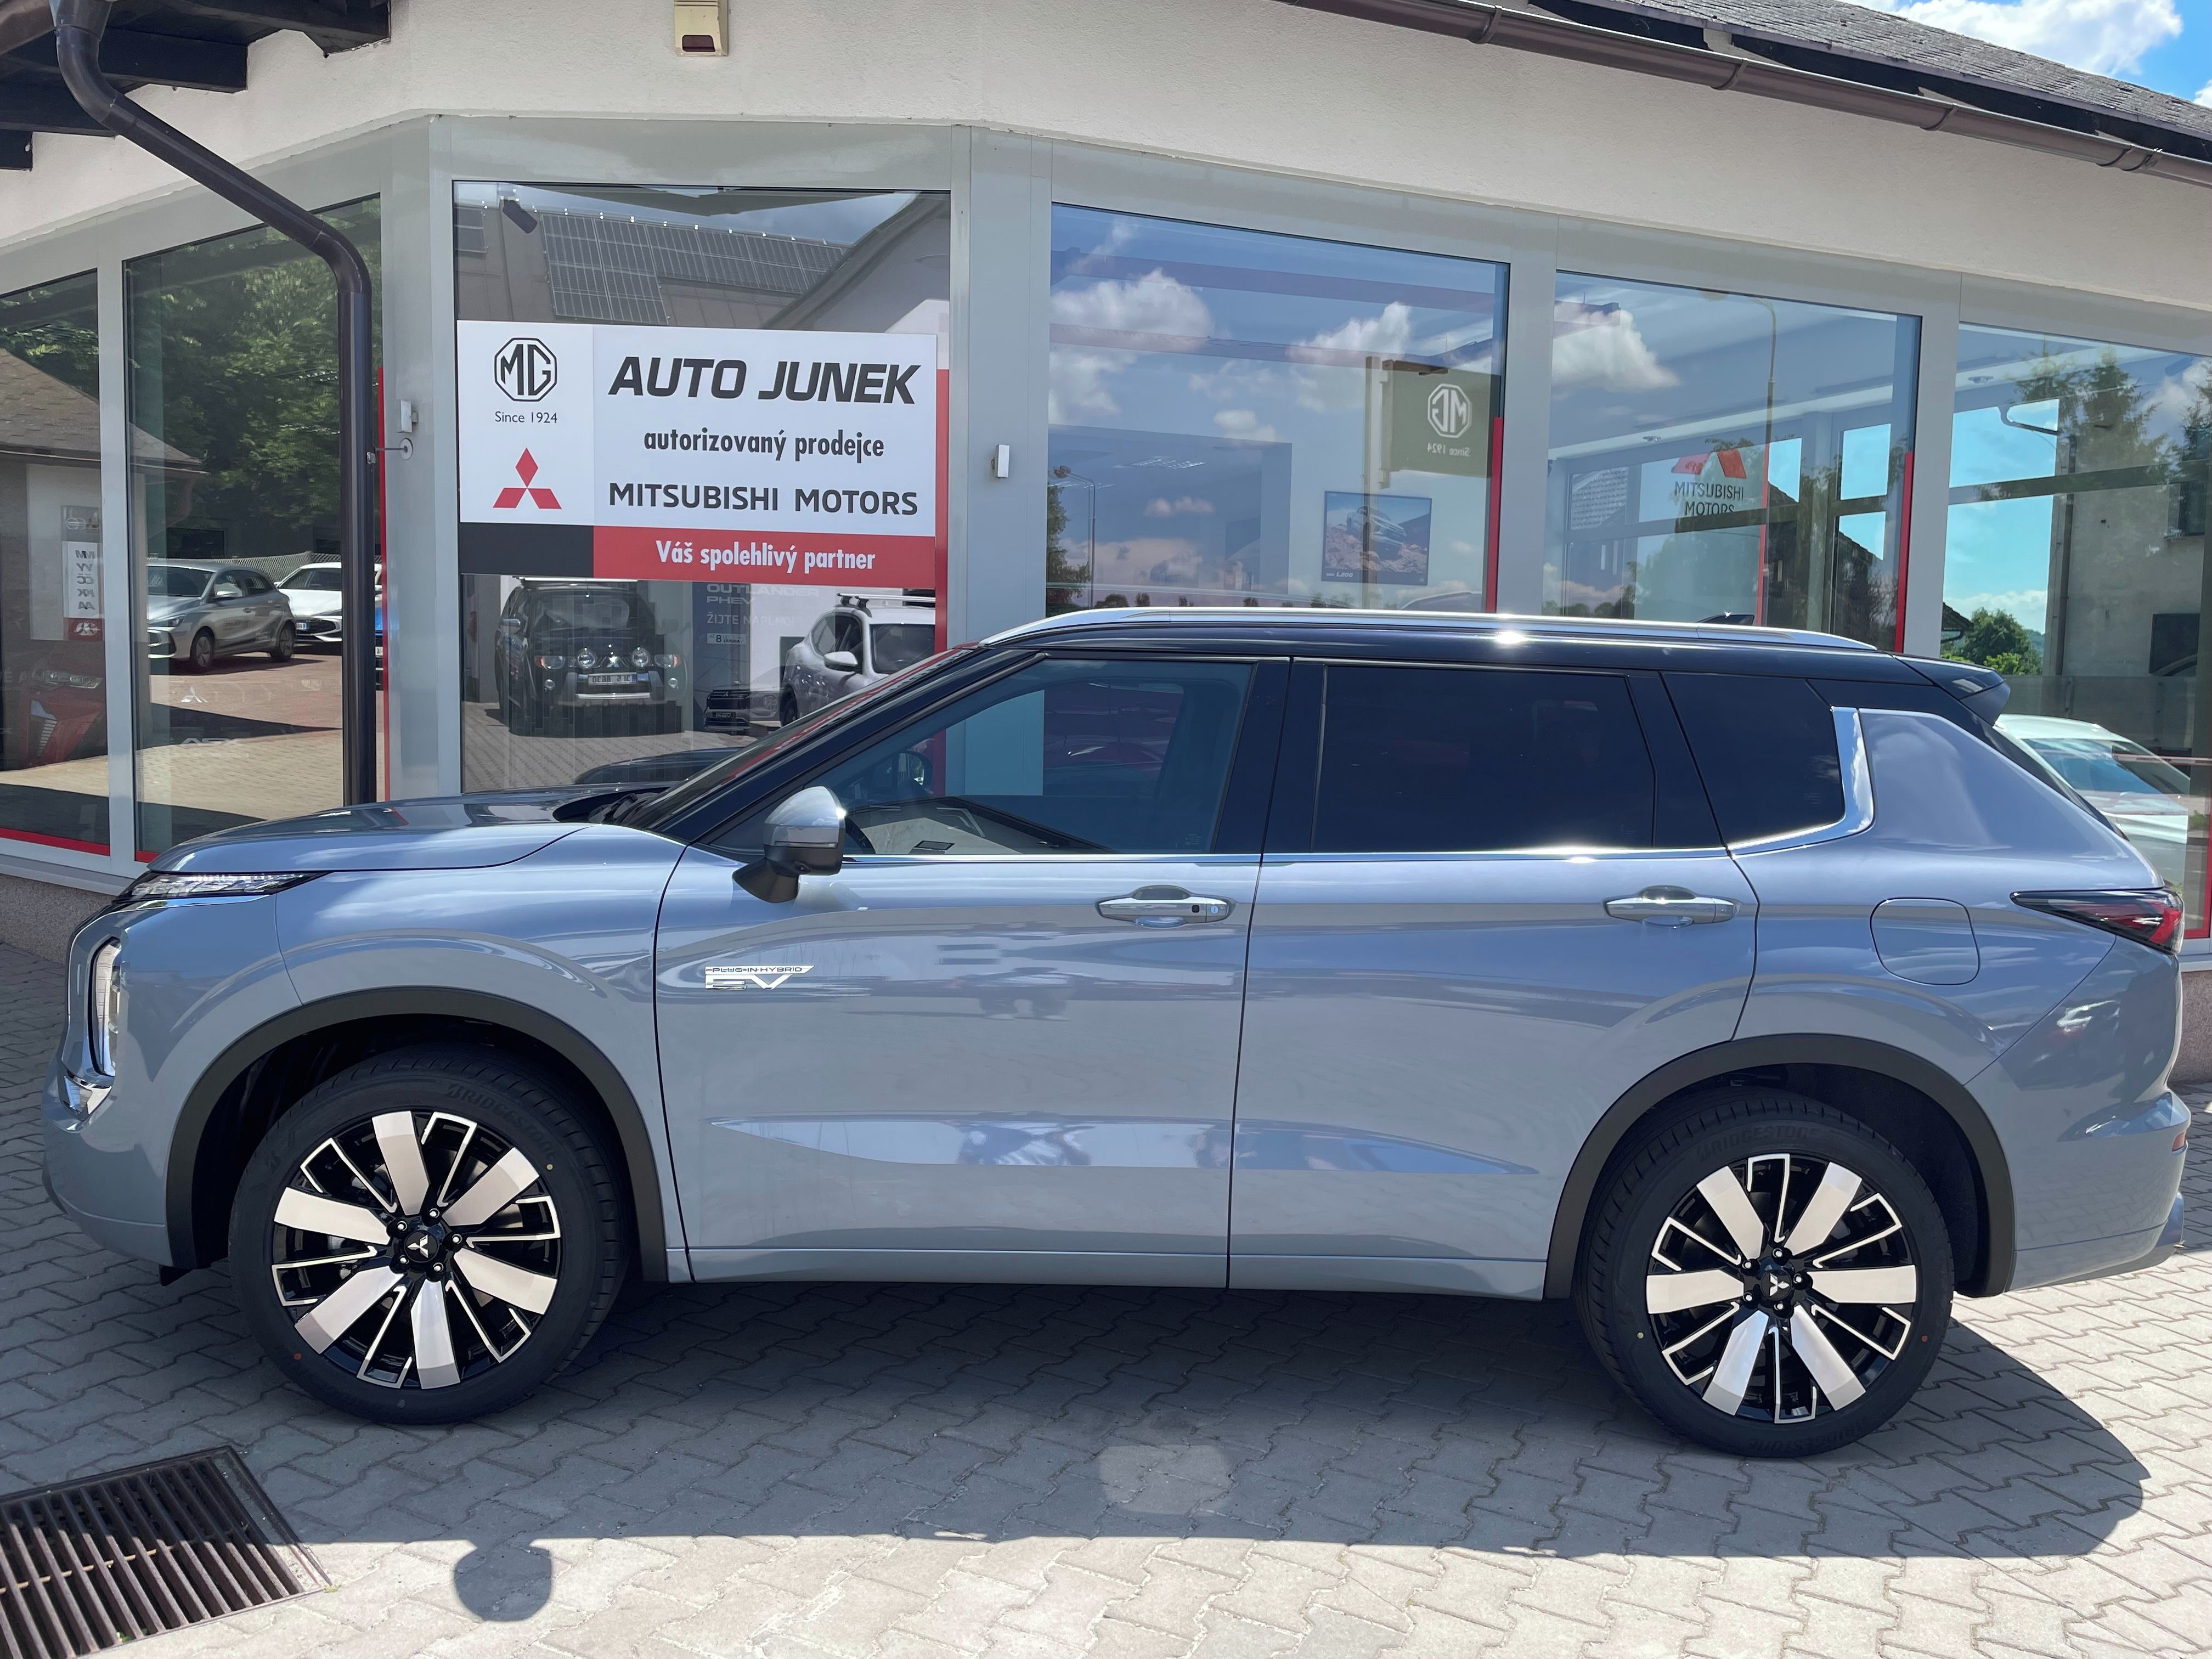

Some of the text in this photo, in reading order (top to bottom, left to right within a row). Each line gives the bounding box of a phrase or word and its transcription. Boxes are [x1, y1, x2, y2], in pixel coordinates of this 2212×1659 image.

[500, 343, 551, 396] MG
[607, 356, 922, 404] AUTO JUNEK
[495, 411, 558, 424] Since 1924
[644, 427, 884, 464] autorizovaný prodejce
[610, 482, 918, 516] MITSUBISHI MOTORS
[1674, 481, 1744, 501] MITSUBISHI
[1685, 500, 1735, 516] MOTORS
[656, 540, 876, 574] Váš spolehlivý partner
[707, 583, 820, 597] OUTLANDER
[707, 596, 755, 605] PHEV
[707, 611, 739, 625] ŽIJTE
[716, 634, 722, 643] 8
